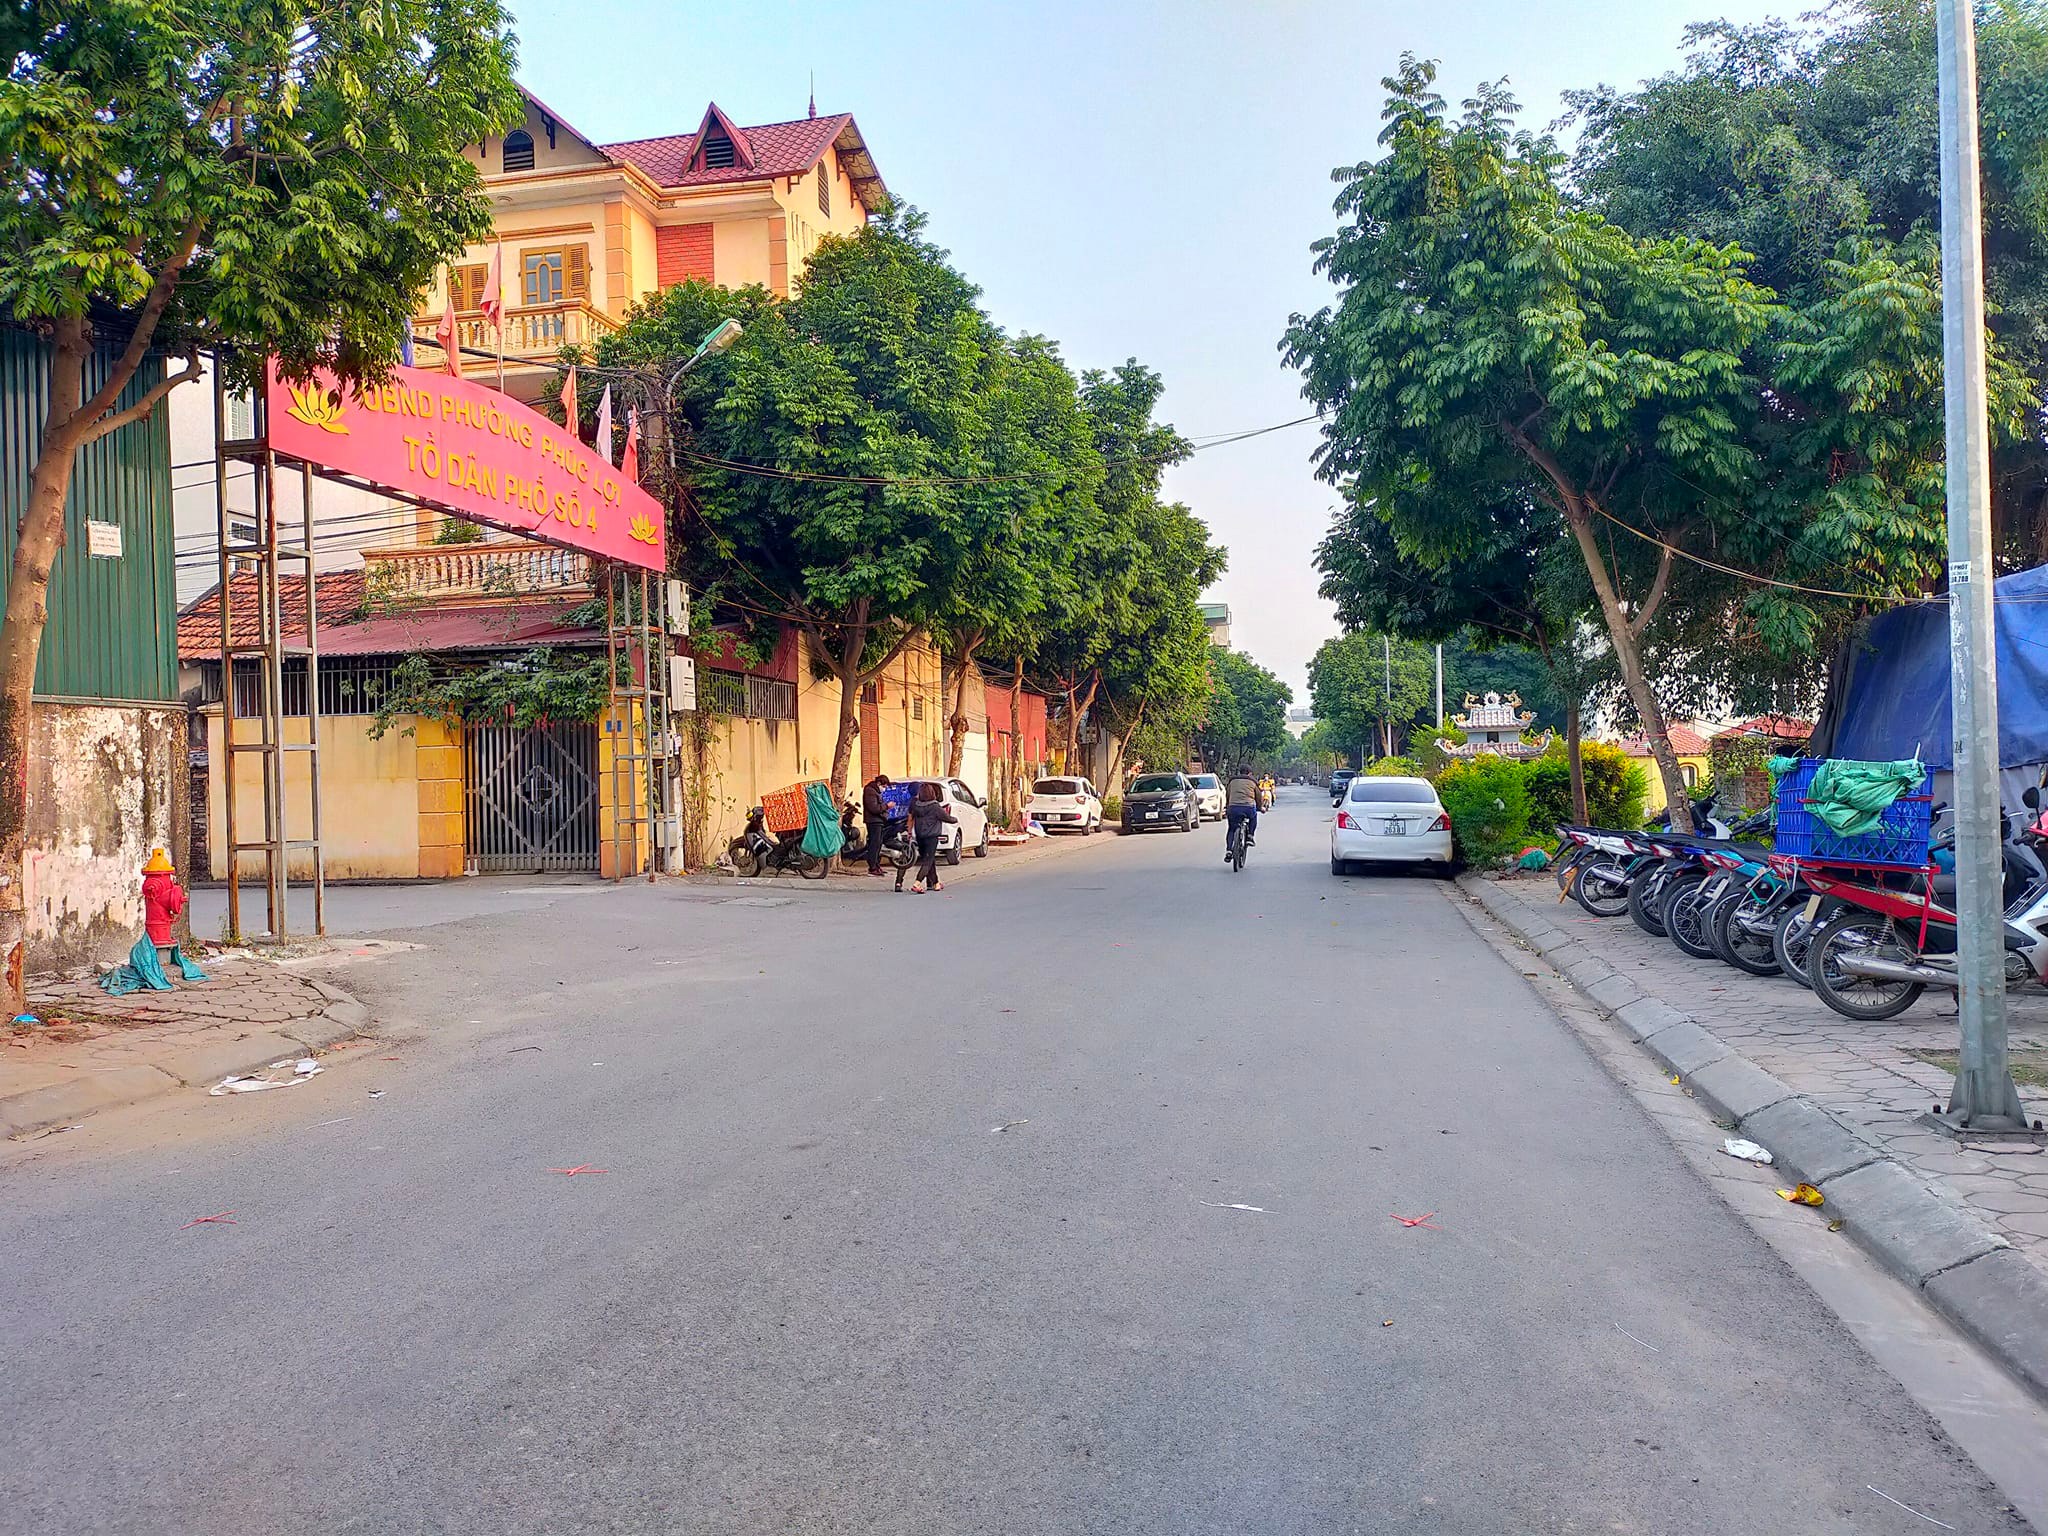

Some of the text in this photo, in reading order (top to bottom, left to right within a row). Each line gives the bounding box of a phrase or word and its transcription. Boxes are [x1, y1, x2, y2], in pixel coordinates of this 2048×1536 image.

[362, 380, 622, 507] UBND PHƯỜNG PHÚC LỢI
[403, 431, 598, 533] TỔ DÂN PHỐ SỐ 4
